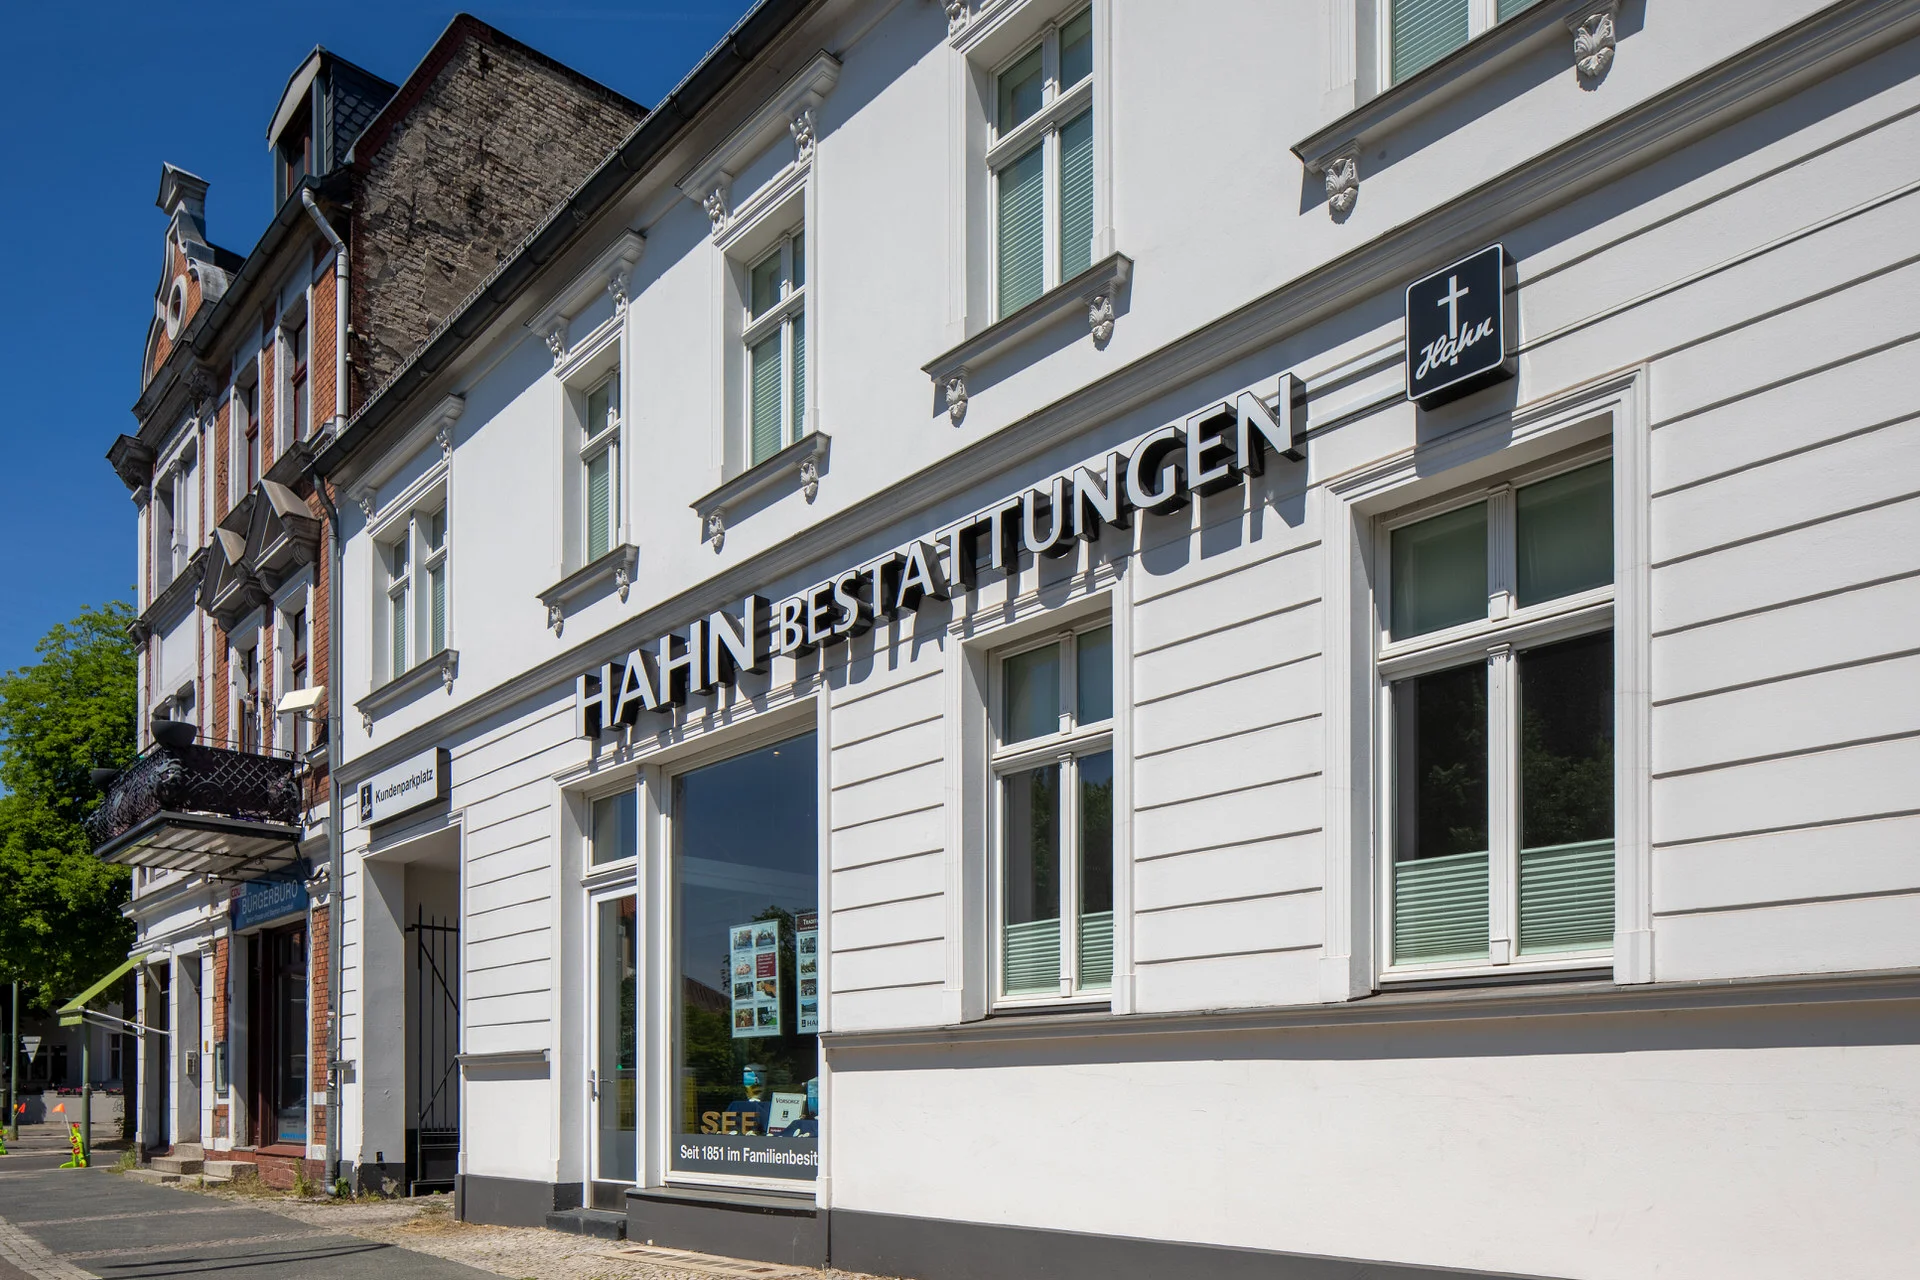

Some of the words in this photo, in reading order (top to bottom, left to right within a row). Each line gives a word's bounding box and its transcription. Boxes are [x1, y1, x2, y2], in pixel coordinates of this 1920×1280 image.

[1415, 316, 1494, 381] Hahn
[576, 594, 764, 740] HAHN
[779, 372, 1300, 656] BESTATTUNGEN
[375, 768, 434, 804] Kundenparkplatz
[241, 879, 298, 915] BÜRGERBÜRO
[680, 1145, 700, 1160] Seit
[701, 1145, 724, 1161] 1851
[727, 1147, 740, 1162] im
